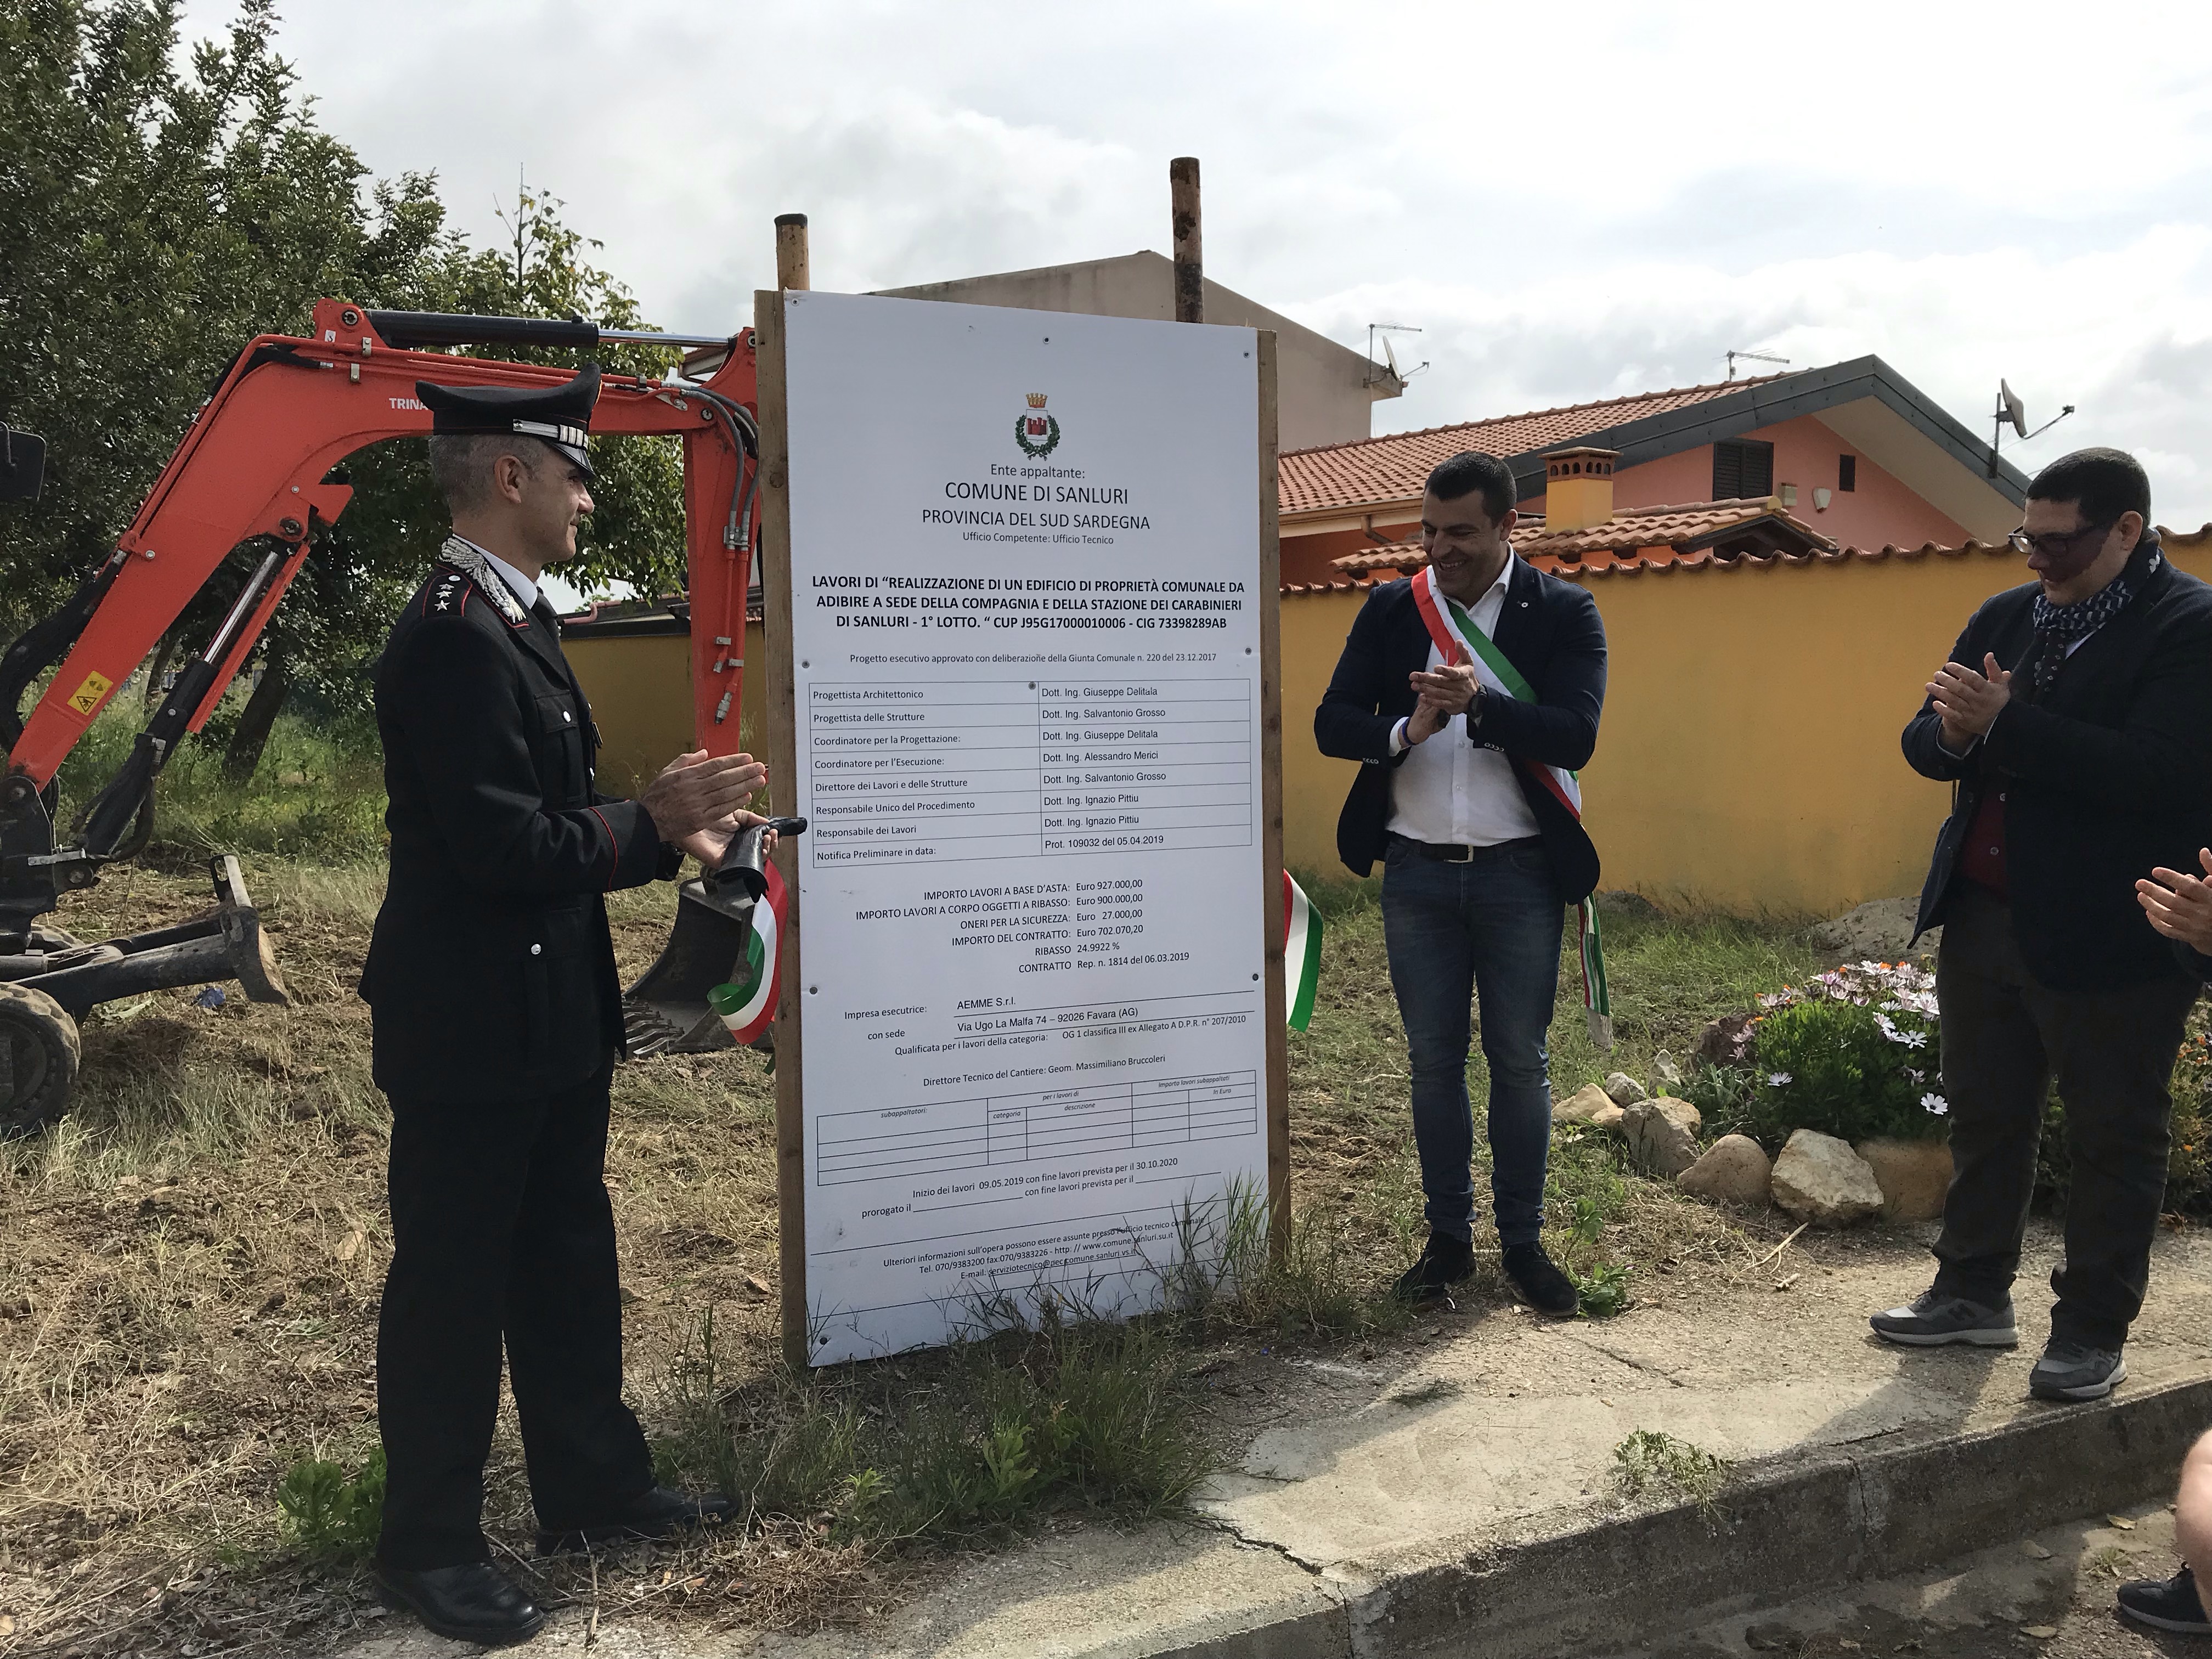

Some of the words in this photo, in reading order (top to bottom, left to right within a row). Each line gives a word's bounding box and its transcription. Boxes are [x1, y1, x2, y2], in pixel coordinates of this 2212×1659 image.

[990, 463, 1017, 476] Ente
[1019, 465, 1085, 479] appaltante:
[945, 481, 1028, 501] COMUNE
[1033, 485, 1050, 502] DI
[1056, 486, 1127, 504] SANLURI
[922, 509, 1005, 526] PROVINCIA
[1009, 512, 1036, 526] DEL
[1039, 512, 1069, 527] SUD
[1073, 514, 1150, 529] SARDEGNA
[962, 531, 991, 541] Ufficio
[993, 532, 1050, 544] Competente:
[1052, 533, 1080, 544] Ufficio
[1081, 534, 1114, 544] Tecnico
[812, 575, 861, 588] LAVORI
[865, 576, 878, 588] DI
[988, 578, 1001, 590] DI
[1004, 579, 1023, 590] UN
[1026, 579, 1076, 591] EDIFICIO
[1079, 580, 1091, 591] DI
[1094, 578, 1159, 592] PROPRIETÀ
[1161, 580, 1226, 592] COMUNALE
[1228, 582, 1245, 592] DA
[816, 595, 870, 607] ADIBIRE
[885, 596, 917, 608] SEDE
[921, 596, 959, 608] DELLA
[961, 597, 1040, 610] COMPAGNIA
[1052, 598, 1088, 610] DELLA
[1091, 599, 1147, 610] STAZIONE
[1150, 599, 1169, 610] DEI
[1171, 599, 1242, 611] CARABINIERI
[836, 615, 850, 627] DI
[853, 615, 909, 628] SANLURI
[936, 616, 980, 628] LOTTO.
[993, 616, 1018, 628] CUP
[1020, 617, 1126, 629] J95G17000010006
[1136, 617, 1155, 629] CIG
[1158, 617, 1227, 629] 73398289AB
[849, 653, 888, 664] Progetto
[889, 653, 930, 663] esecutivo
[931, 654, 974, 664] approvato
[991, 653, 1046, 662] deliberazione
[1047, 653, 1066, 662] della
[1068, 653, 1094, 662] Giunta
[1096, 653, 1135, 662] Comunale
[1146, 653, 1161, 662] 220
[1161, 652, 1174, 662] del
[1175, 653, 1217, 661] 23.12.2017
[812, 690, 861, 701] Progettista
[862, 690, 923, 699] Architettonico
[1041, 687, 1062, 697] Dott.
[1064, 687, 1081, 699] Ing.
[1082, 687, 1124, 698] Giuseppe
[1126, 686, 1158, 696] Delitala
[1042, 753, 1063, 762] Dott.
[1065, 752, 1081, 764] Ing.
[1084, 751, 1132, 761] Alessandro
[1133, 750, 1158, 760] Merici
[815, 782, 855, 792] Direttore
[857, 781, 871, 791] dei
[872, 780, 899, 789] Lavori
[907, 779, 929, 788] delle
[930, 779, 968, 788] Strutture
[1043, 796, 1064, 806] Dott.
[1066, 795, 1082, 806] Ing.
[1085, 794, 1116, 806] Ignazio
[1118, 793, 1139, 803] Pittiu
[815, 803, 873, 816] Responsabile
[875, 803, 900, 812] Unico
[901, 802, 915, 811] del
[917, 800, 975, 810] Procedimento
[1045, 839, 1065, 849] Prot.
[1068, 837, 1099, 848] 109032
[1101, 837, 1115, 847] del
[1116, 834, 1164, 845] 05.04.2019
[816, 850, 851, 860] Notifica
[853, 848, 903, 859] Preliminare
[905, 847, 913, 856] in
[915, 846, 936, 855] data:
[923, 889, 968, 900] IMPORTO
[969, 887, 1002, 898] LAVORI
[1012, 885, 1035, 895] BASE
[1075, 882, 1096, 891] Euro
[1096, 878, 1143, 890] 927.000,00
[855, 908, 901, 920] IMPORTO
[903, 906, 936, 917] LAVORI
[947, 903, 980, 914] CORPO
[981, 900, 1020, 912] OGGETTI
[1031, 898, 1070, 909] RIBASSO:
[1076, 896, 1096, 906] Euro
[1097, 893, 1143, 905] 900.000,00
[1018, 960, 1071, 973] CONTRATTO
[1077, 960, 1096, 969] Rep.
[1108, 956, 1128, 966] 1814
[1130, 955, 1143, 964] del
[1144, 951, 1189, 963] 06.03.2019
[956, 997, 993, 1010] AEMME
[995, 996, 1015, 1006] S.r.l.
[844, 1010, 879, 1020] Impresa
[881, 1005, 927, 1017] esecutrice:
[957, 1022, 972, 1032] Via
[974, 1020, 993, 1032] Ugo
[995, 1019, 1007, 1028] La
[1009, 1016, 1034, 1027] Malfa
[1035, 1015, 1047, 1024] 74
[1057, 1011, 1085, 1023] 92026
[1086, 1011, 1116, 1020] Favara
[1118, 1007, 1138, 1019] (AG)
[923, 1076, 961, 1087] Direttore
[962, 1071, 994, 1082] Tecnico
[995, 1069, 1008, 1079] del
[1009, 1067, 1046, 1077] Cantiere:
[1047, 1065, 1074, 1074] Geom.
[1075, 1059, 1126, 1071] Massimiliano
[1127, 1054, 1165, 1065] Bruccoleri
[912, 1188, 935, 1198] Inizio
[936, 1185, 950, 1195] dei
[951, 1182, 975, 1193] lavori
[978, 1176, 1024, 1189] 09.05.2019
[1025, 1176, 1040, 1184] con
[1041, 1172, 1057, 1182] fine
[1058, 1169, 1081, 1180] lavori
[1082, 1166, 1113, 1178] prevista
[1114, 1165, 1128, 1175] per
[1129, 1161, 1134, 1171] il
[1136, 1157, 1178, 1170] 30.10.2020
[883, 1255, 916, 1267] Ulteriori
[917, 1248, 966, 1262] informazioni
[1005, 1240, 1036, 1251] possono
[1037, 1236, 1061, 1245] essere
[1062, 1232, 1090, 1242] assunte
[934, 1257, 985, 1272] 070/9383200
[986, 1248, 1048, 1264] fax:070/9383226
